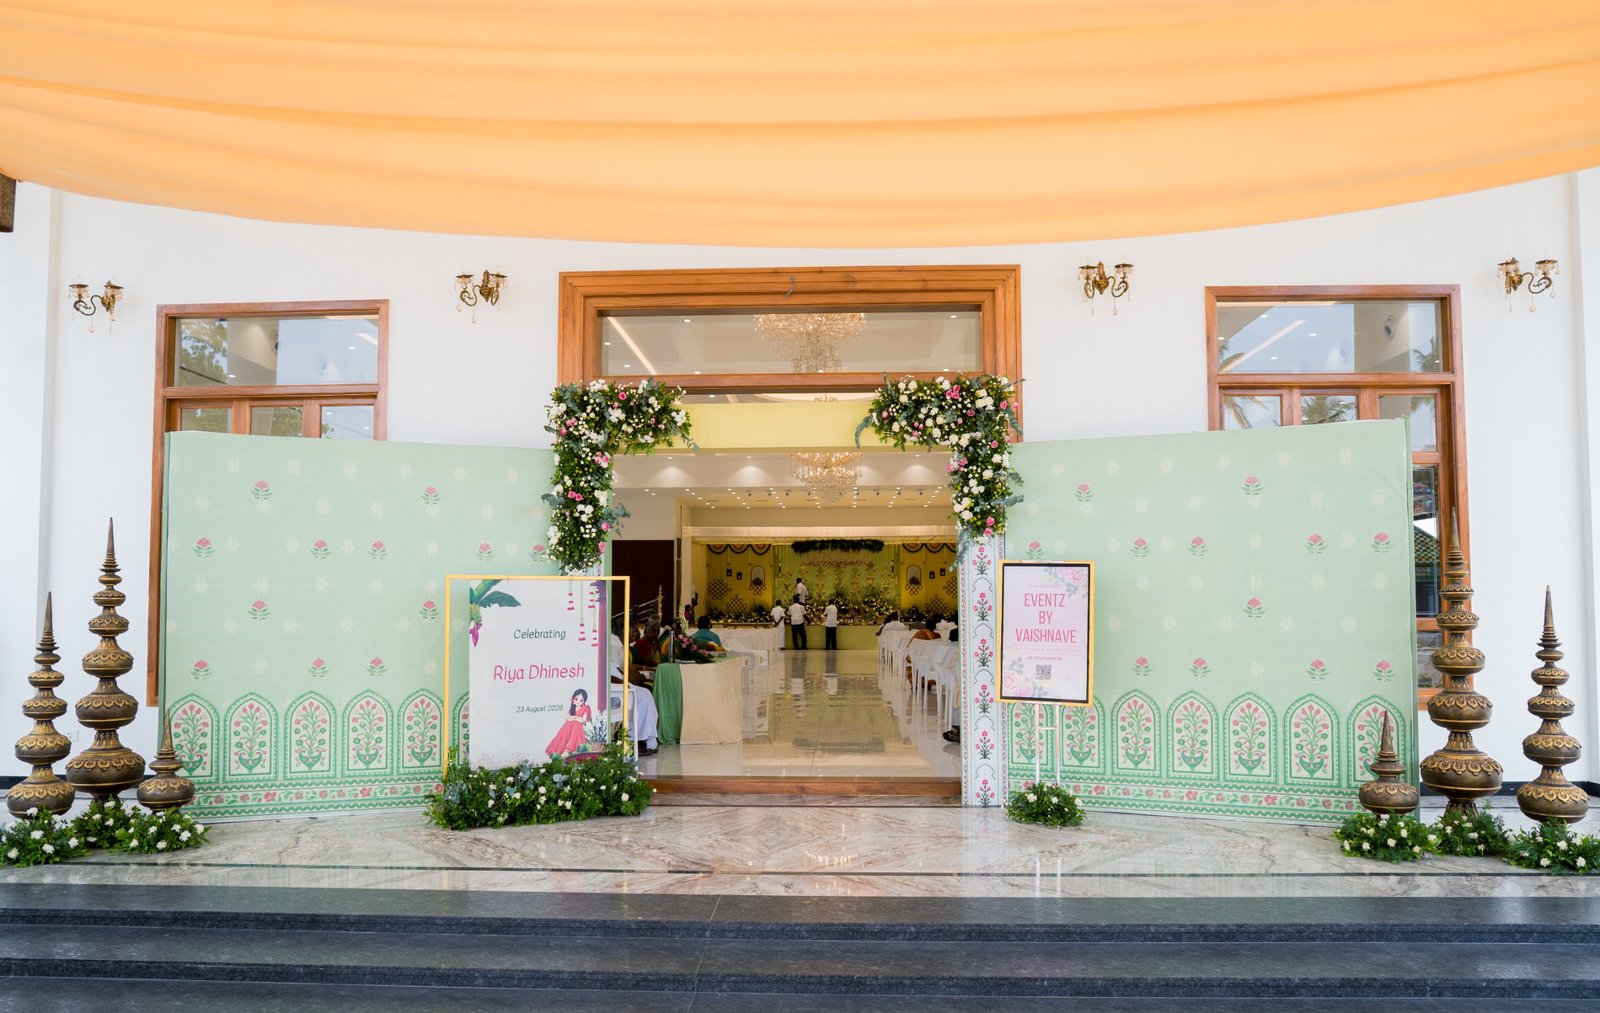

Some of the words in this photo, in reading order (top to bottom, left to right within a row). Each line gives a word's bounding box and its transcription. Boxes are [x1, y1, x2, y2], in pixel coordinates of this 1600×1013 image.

[1024, 593, 1065, 607] EVENTZ
[1038, 610, 1053, 624] BY
[513, 628, 566, 640] Celebrating
[1015, 629, 1077, 643] VAISHNAVE
[493, 665, 525, 683] Riya
[528, 662, 585, 680] Dhinesh
[516, 705, 525, 713] 23
[526, 704, 546, 713] August
